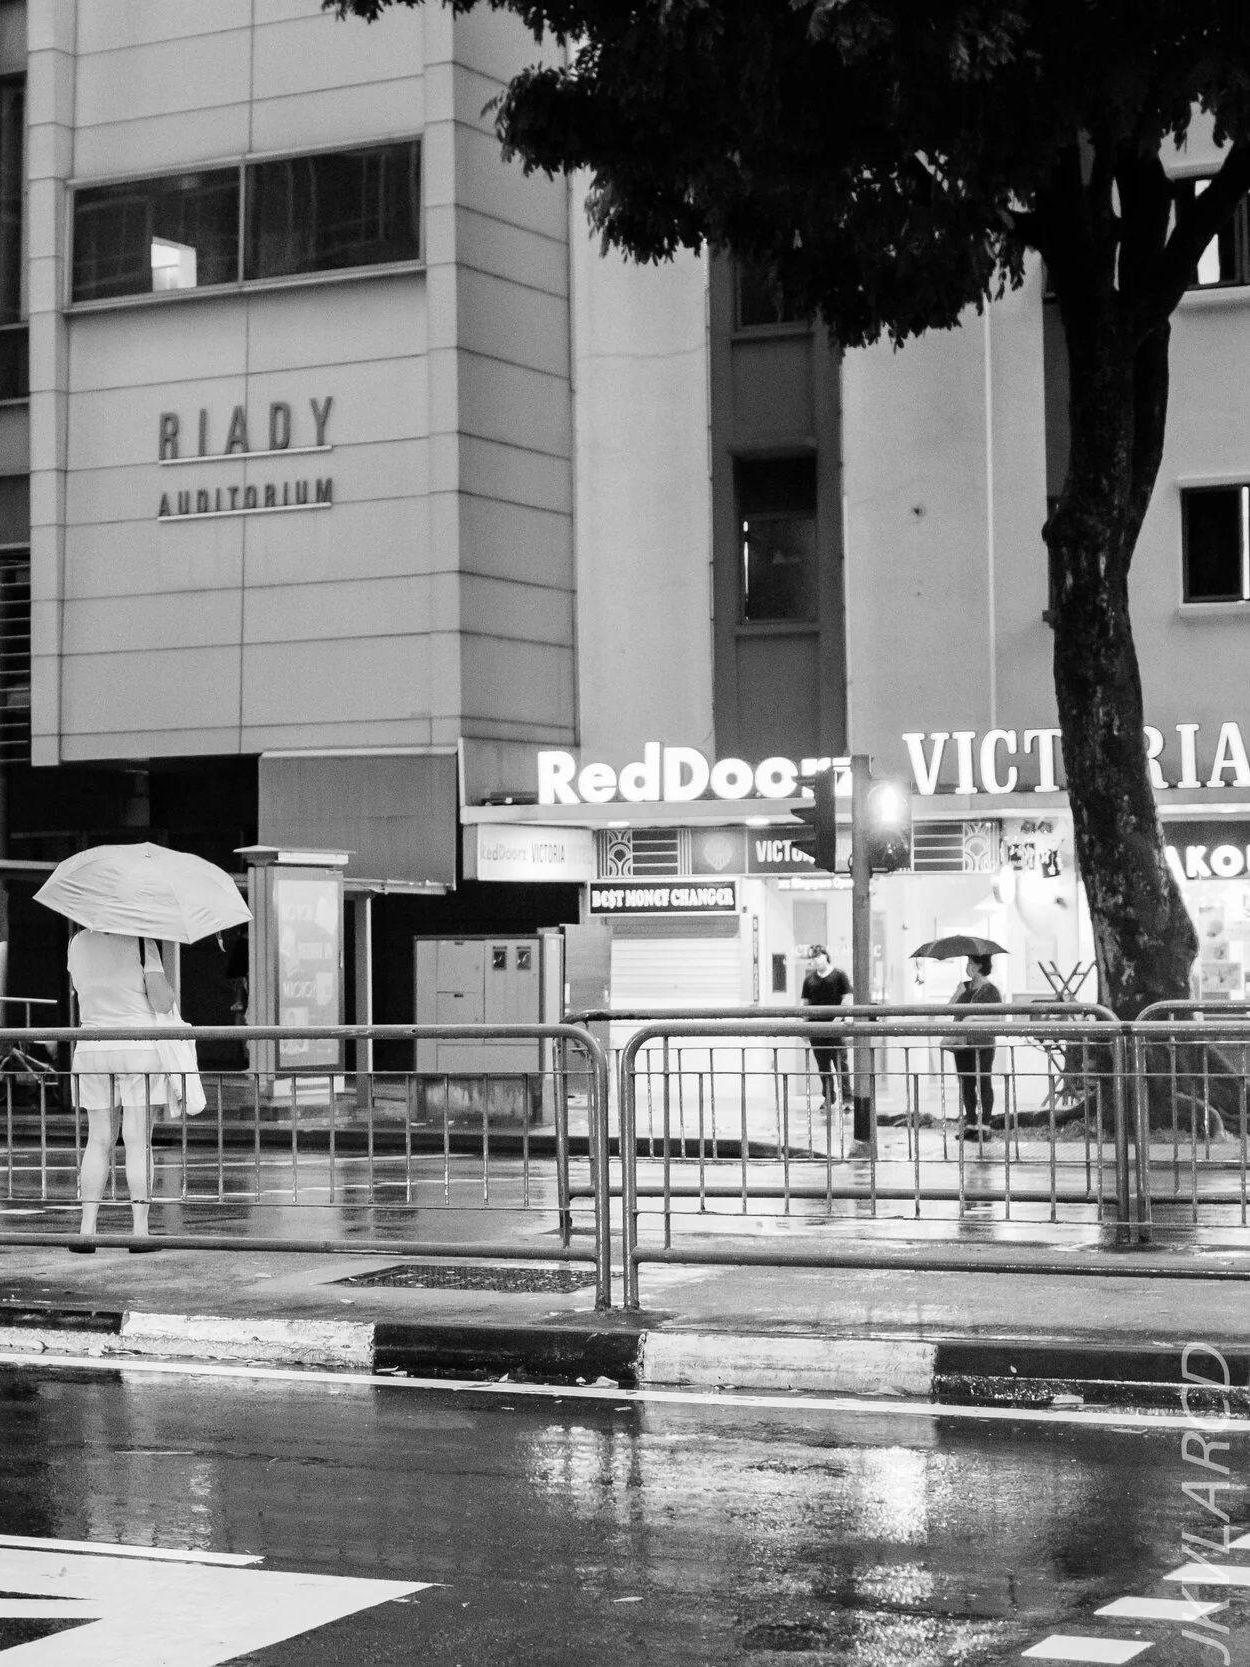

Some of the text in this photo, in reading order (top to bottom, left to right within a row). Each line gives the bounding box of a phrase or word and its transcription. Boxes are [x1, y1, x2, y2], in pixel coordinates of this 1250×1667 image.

[158, 395, 334, 461] RIADY
[158, 476, 333, 517] AUDITORIUM
[901, 720, 1250, 796] VICTRIA
[531, 843, 566, 864] VICTORIA
